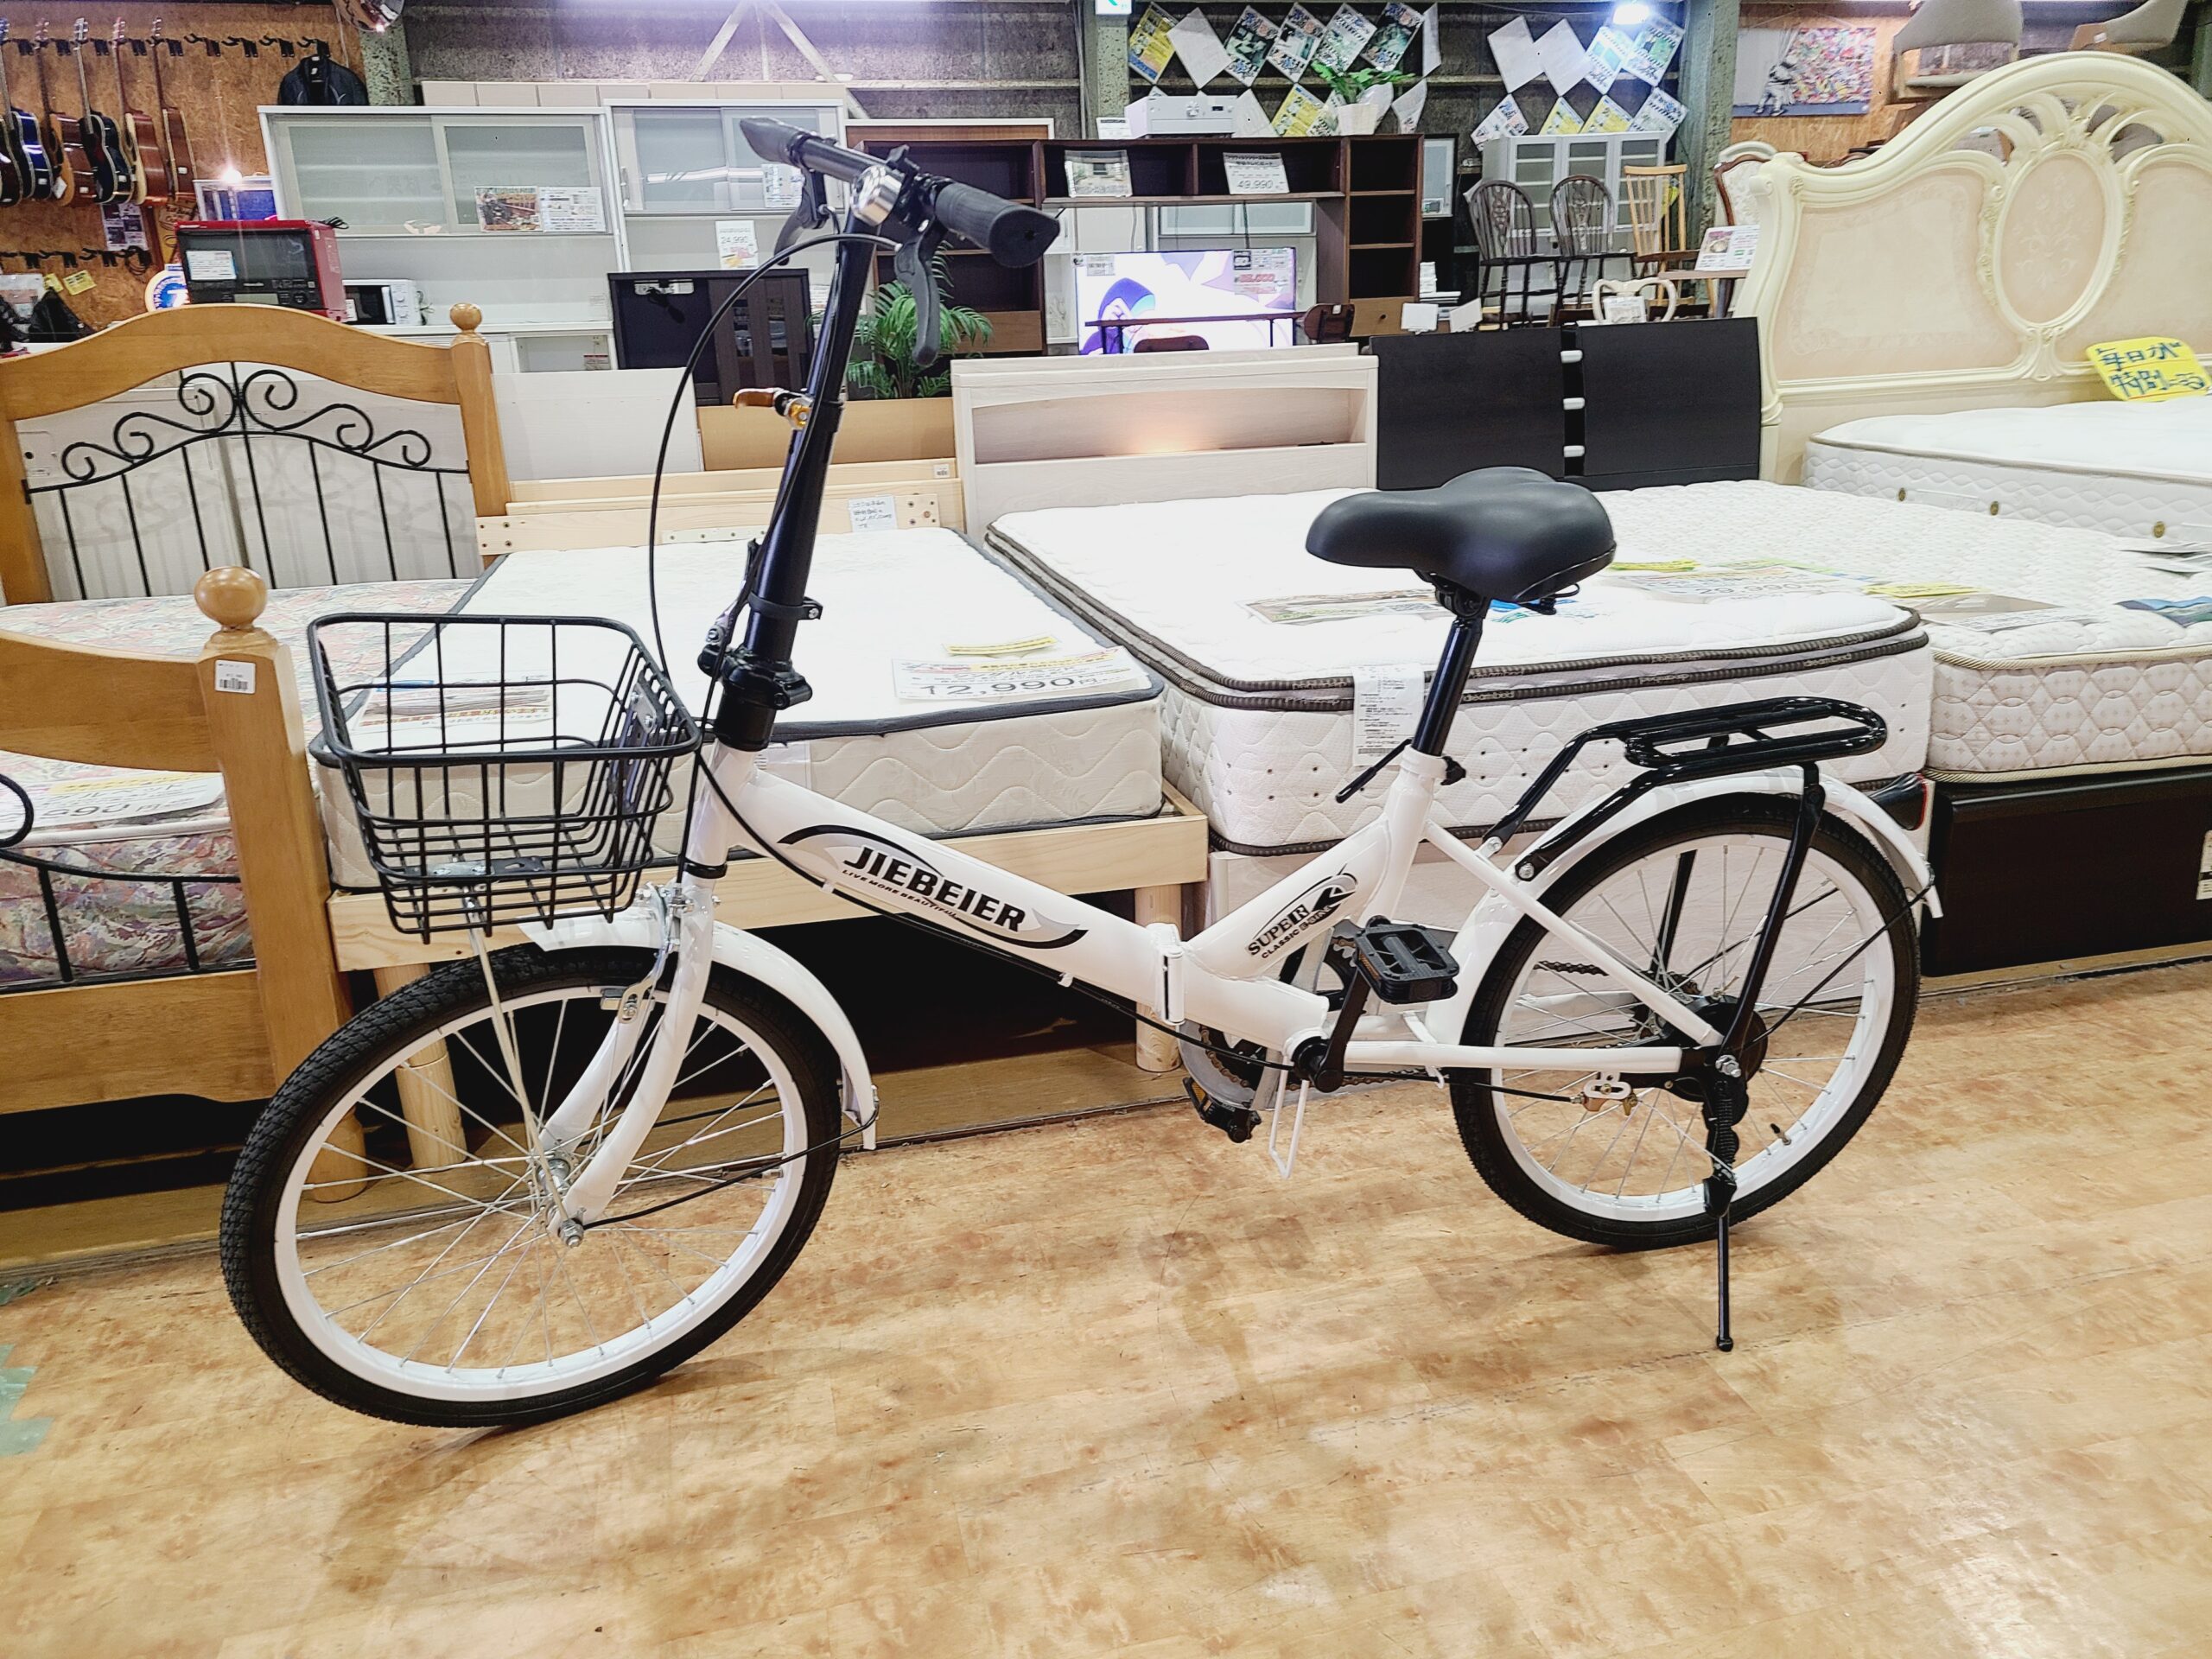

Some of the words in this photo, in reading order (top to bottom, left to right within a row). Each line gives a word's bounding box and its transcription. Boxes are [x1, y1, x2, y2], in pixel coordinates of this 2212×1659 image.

[842, 846, 1027, 933] JIEBEIER
[842, 869, 868, 882] LIVE
[868, 880, 899, 894] MORE
[899, 893, 959, 919] BEAUTIFUL
[1248, 904, 1311, 955] SUPER
[1262, 928, 1300, 958] CLASSIC
